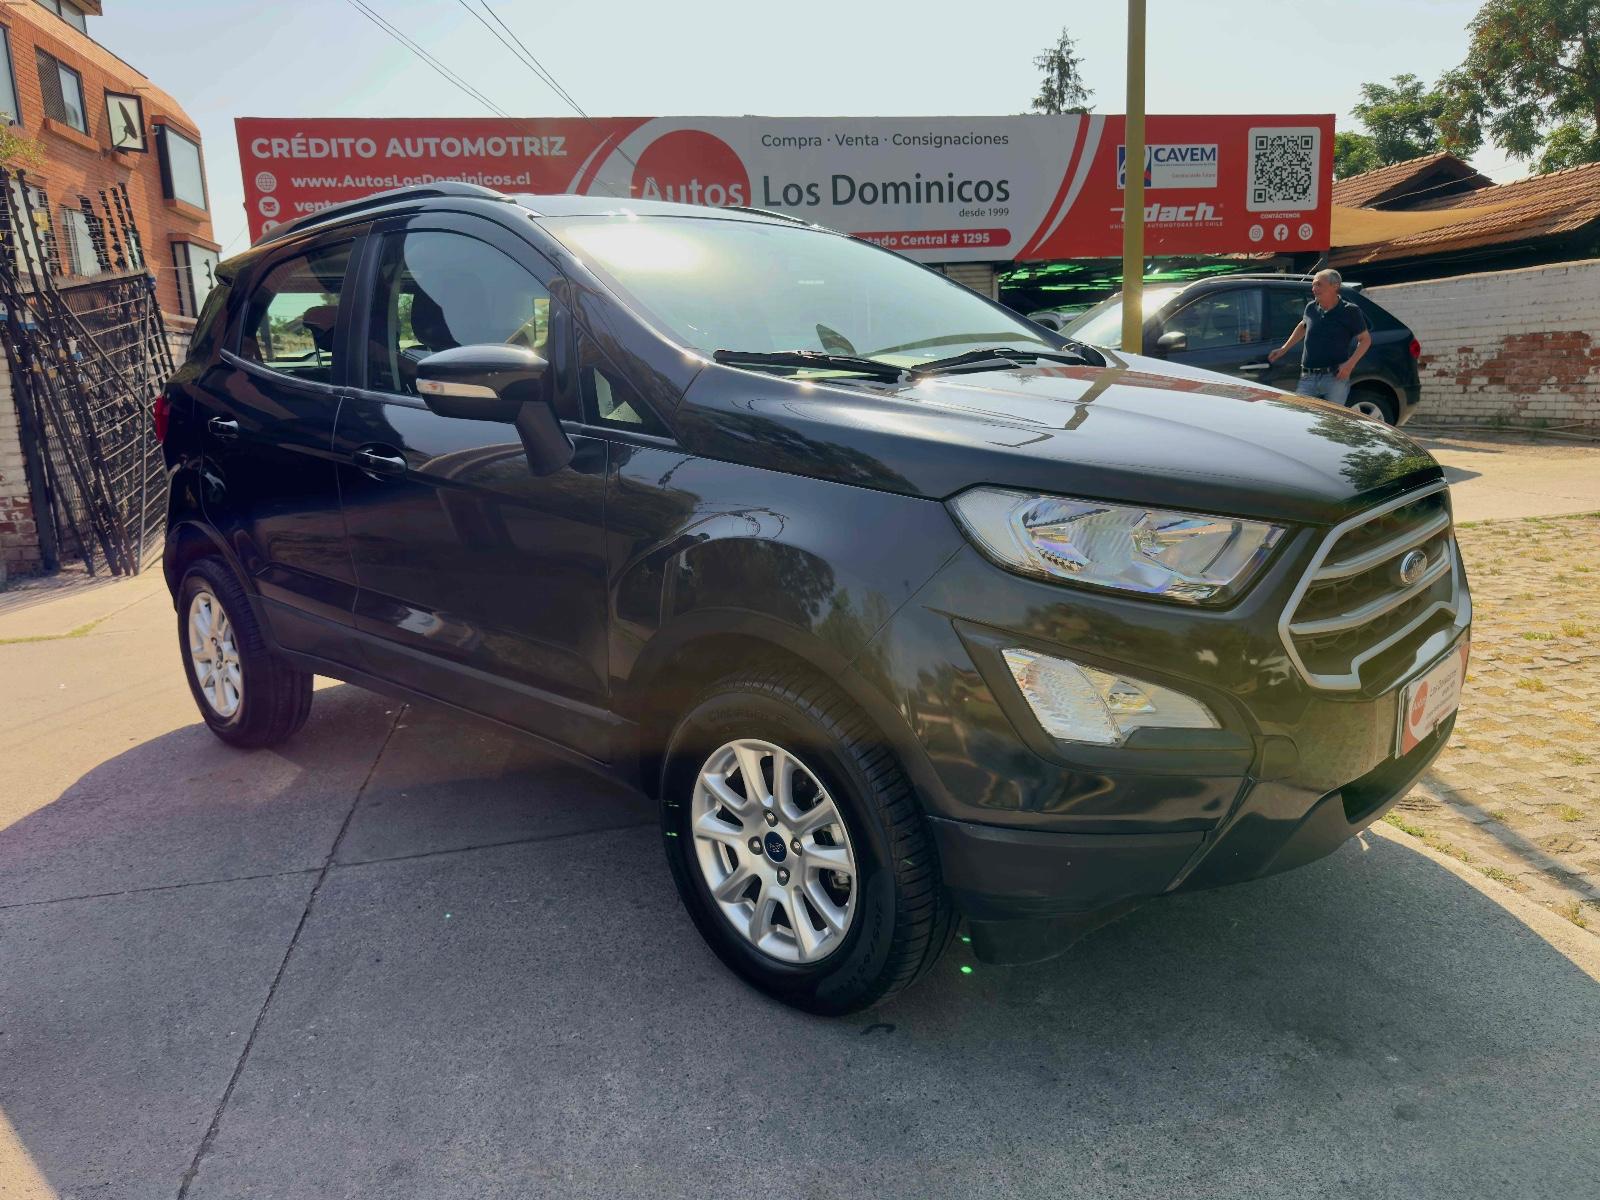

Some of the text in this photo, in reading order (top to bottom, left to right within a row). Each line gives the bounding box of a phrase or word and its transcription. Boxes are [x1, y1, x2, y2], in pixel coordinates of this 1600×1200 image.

[251, 133, 568, 159] CRÉDITO AUTOMOTRIZ
[761, 132, 1009, 150] Compra Venta Consignaciones
[1153, 147, 1216, 163] CAVEM
[291, 171, 531, 188] www.AutosLosDominicos.cl
[642, 176, 745, 208] Autos
[763, 172, 1010, 207] Los Dominicos
[959, 207, 1010, 217] desde 1999
[901, 234, 947, 246] Central
[963, 233, 990, 244] 1295
